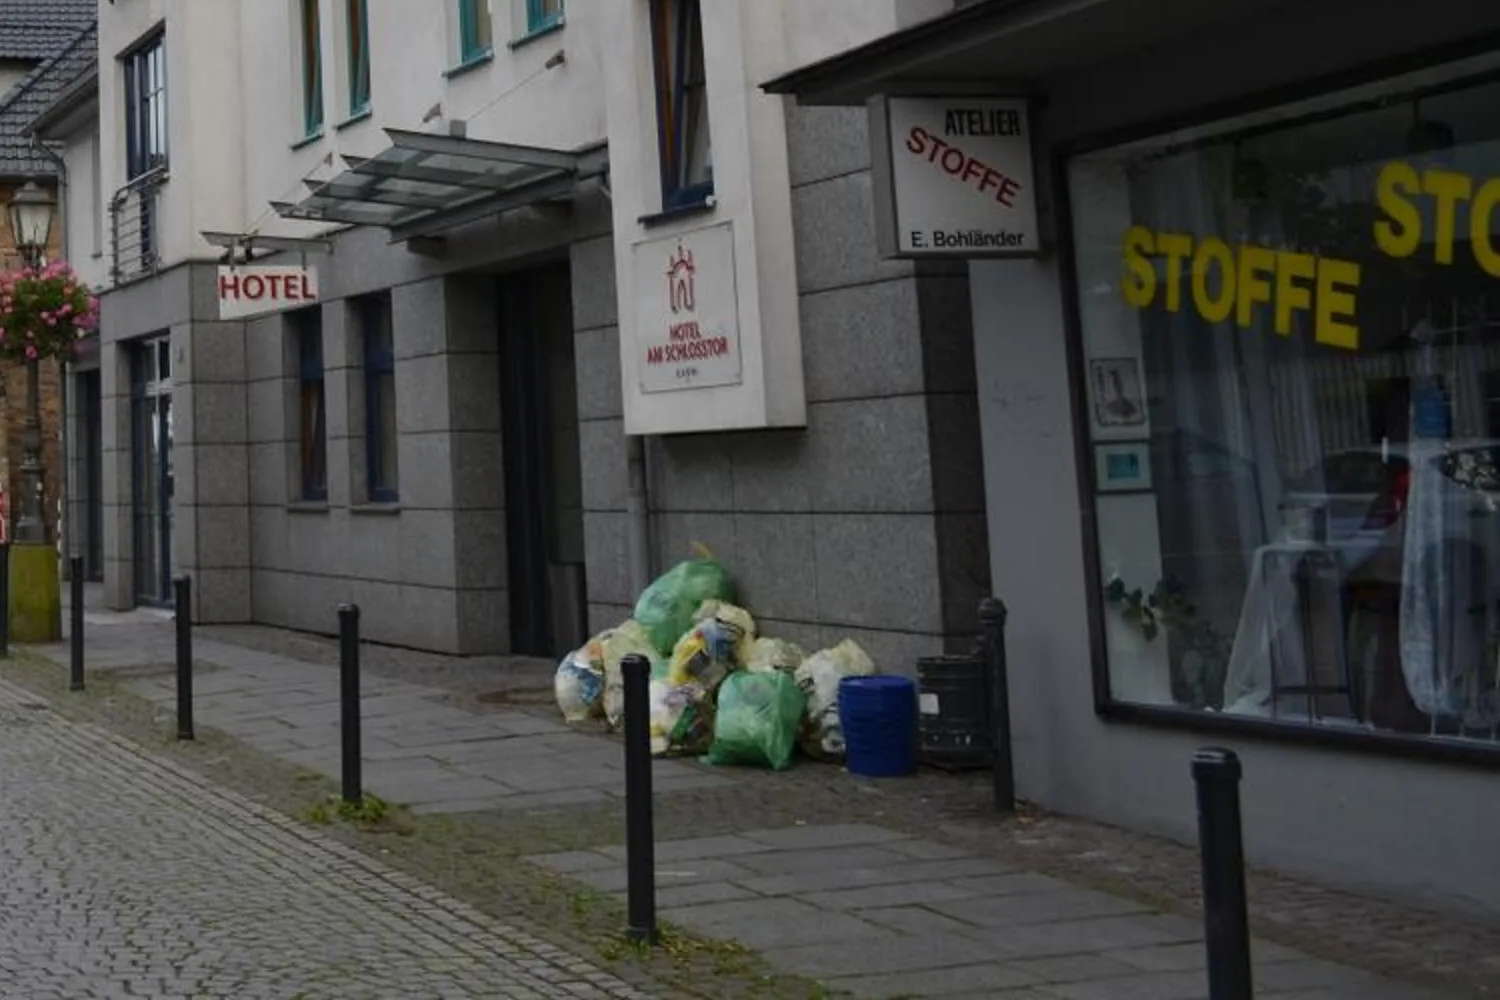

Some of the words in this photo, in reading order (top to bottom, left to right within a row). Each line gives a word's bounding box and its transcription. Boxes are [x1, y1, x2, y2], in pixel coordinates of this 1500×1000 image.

[946, 109, 1021, 137] ATELIER
[905, 126, 1021, 208] STOFFE
[911, 231, 929, 248] E.
[933, 230, 1025, 247] Bohländer
[220, 274, 316, 300] HOTEL
[1121, 225, 1361, 350] STOFFE
[668, 321, 702, 341] HOTEL
